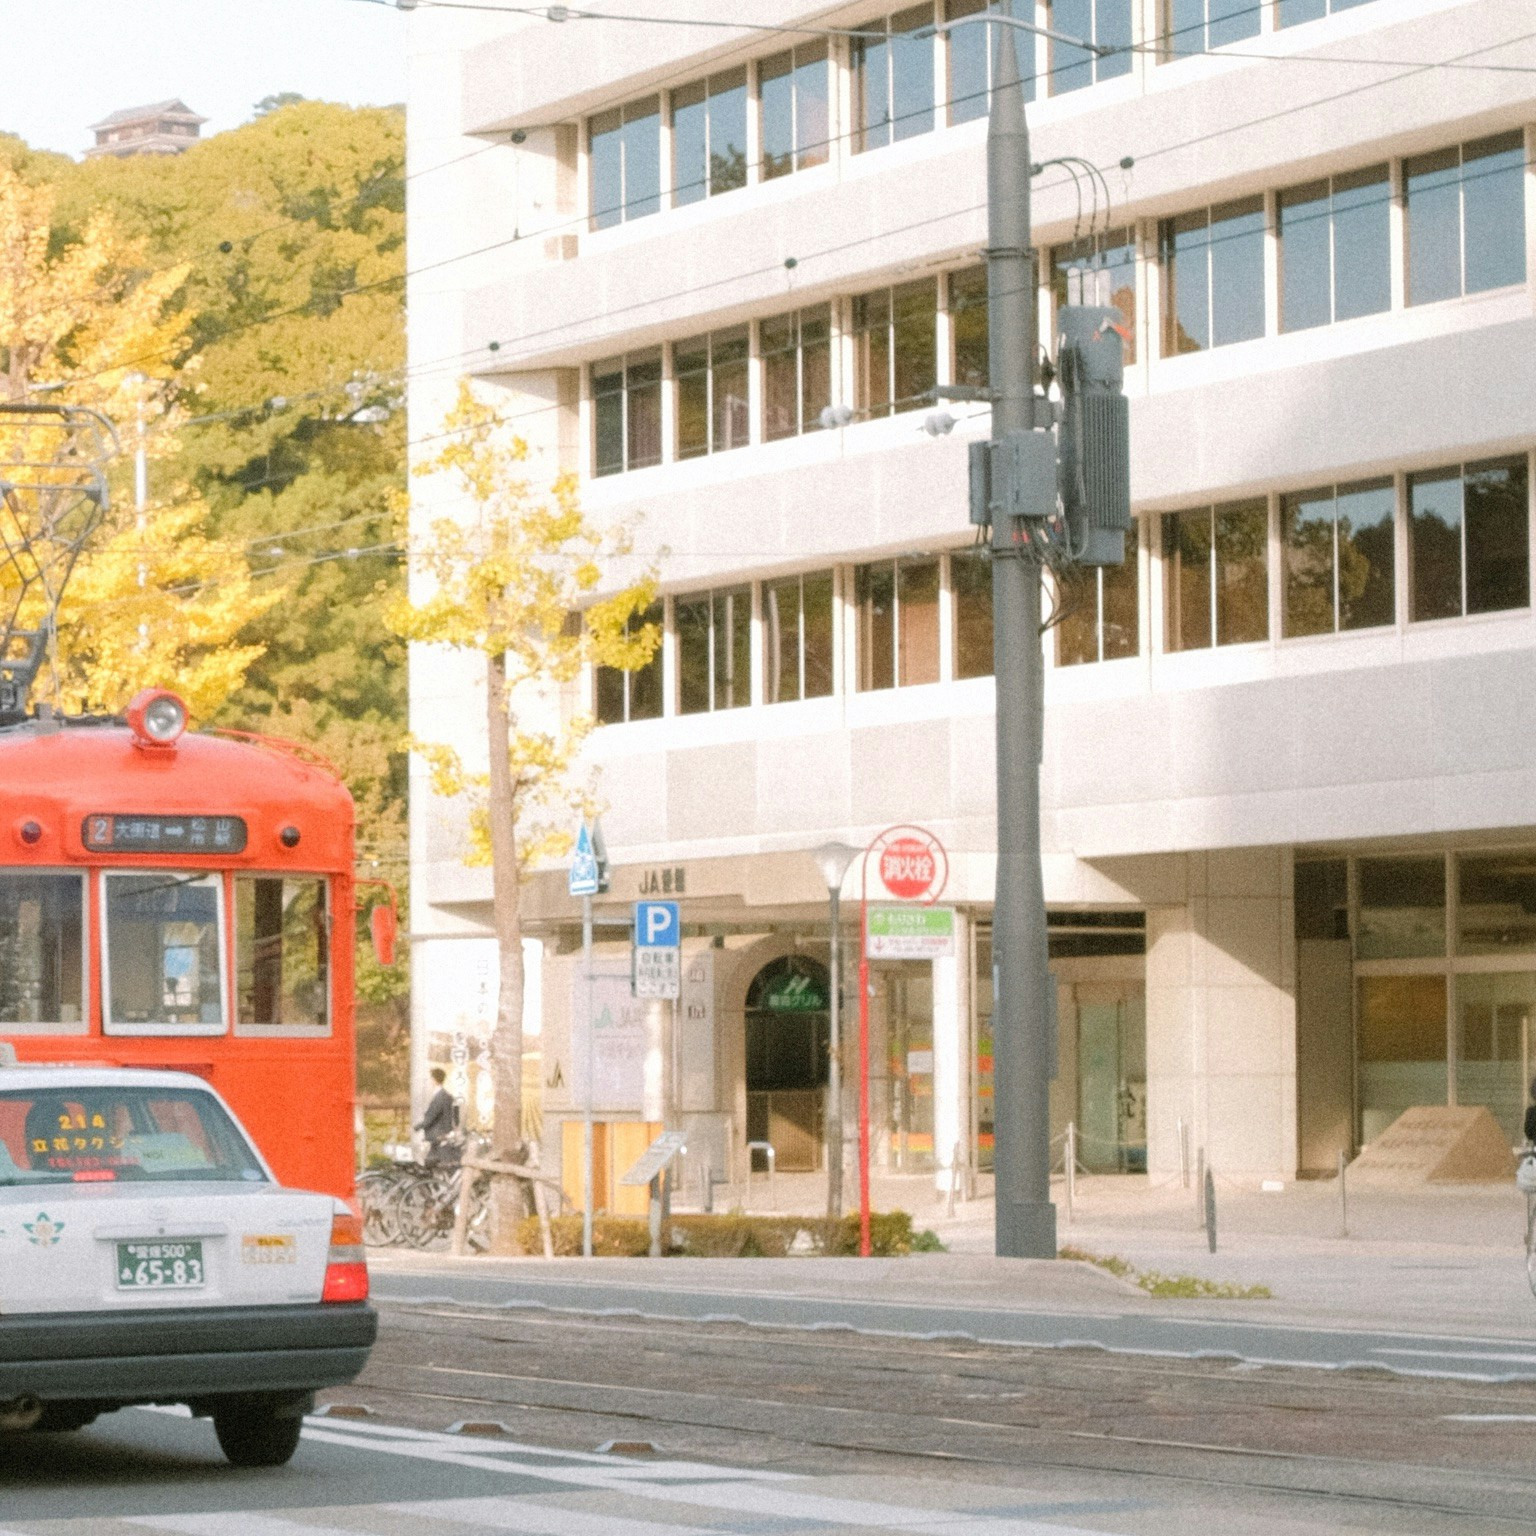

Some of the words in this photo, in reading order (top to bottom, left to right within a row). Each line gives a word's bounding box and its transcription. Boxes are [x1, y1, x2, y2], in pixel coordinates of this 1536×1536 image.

[94, 818, 108, 842] 2
[884, 853, 932, 882] 消火栓
[646, 905, 672, 944] P
[58, 1113, 106, 1131] 214
[135, 1259, 203, 1286] 65-83
